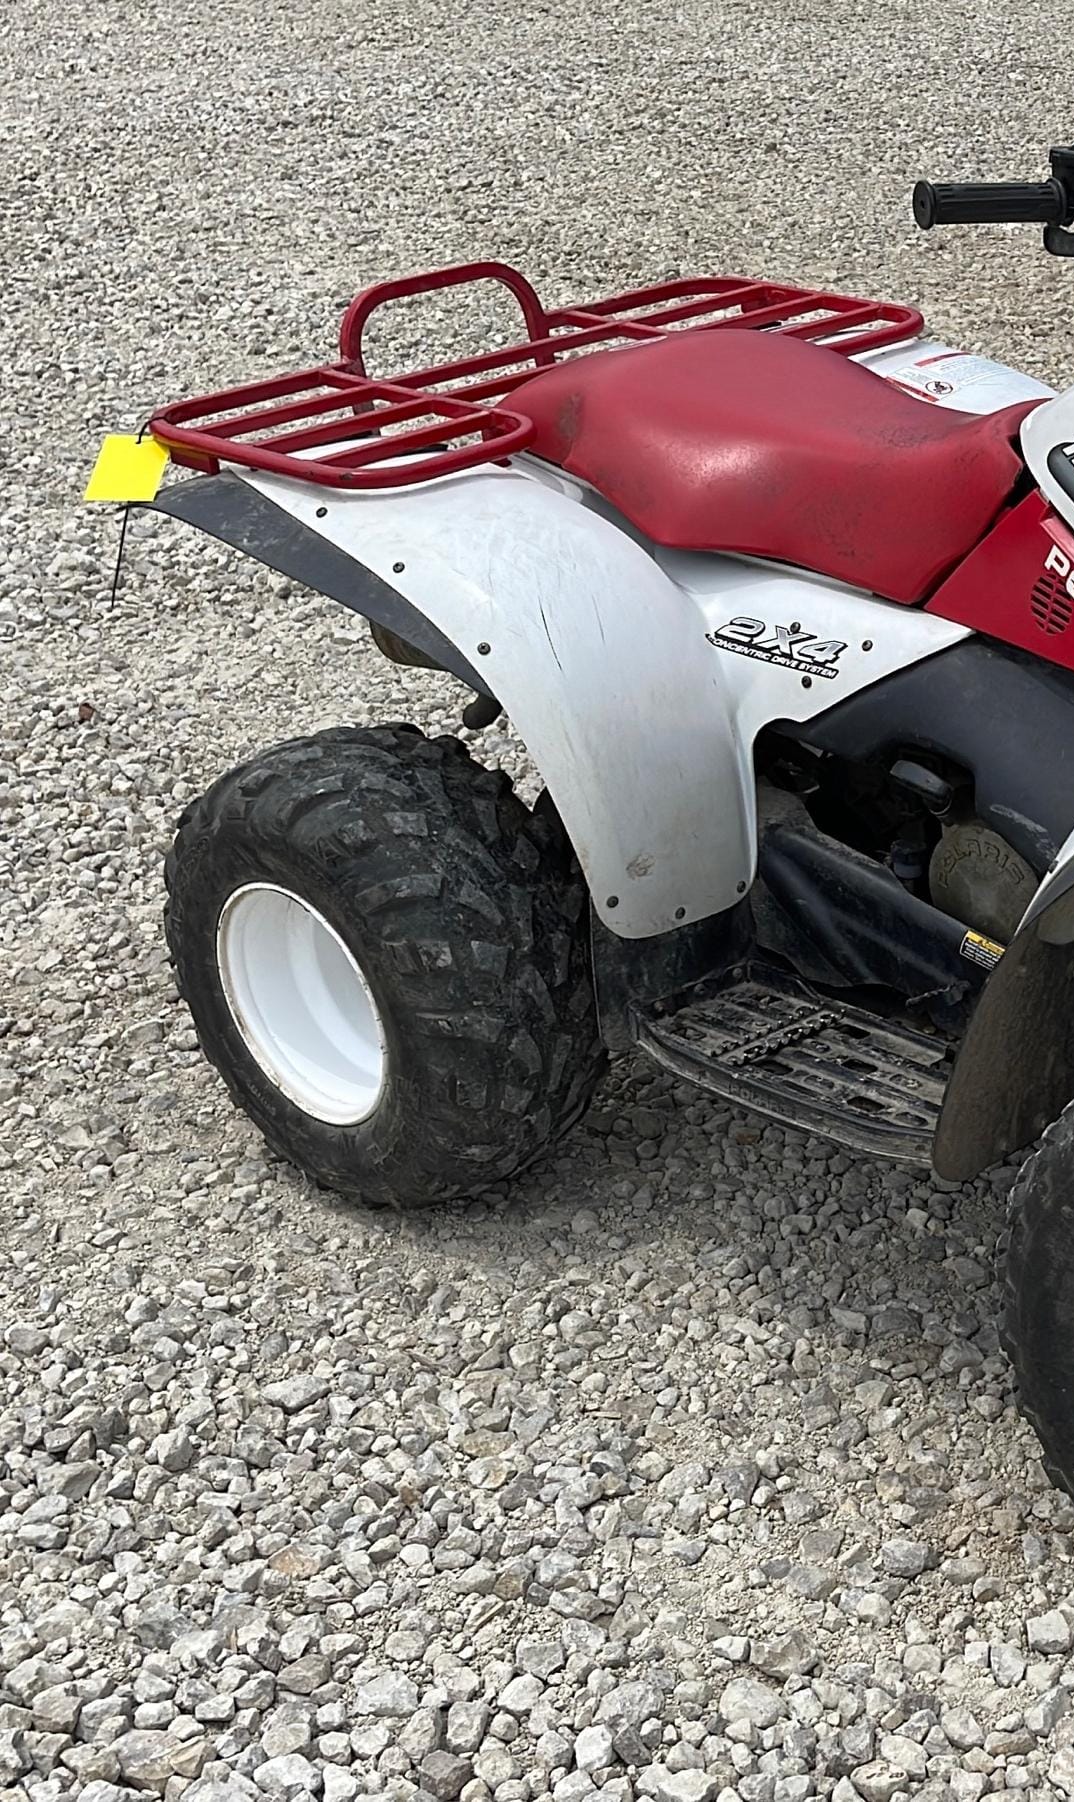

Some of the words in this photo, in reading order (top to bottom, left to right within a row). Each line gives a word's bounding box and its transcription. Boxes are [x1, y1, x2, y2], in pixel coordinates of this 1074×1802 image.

[771, 655, 799, 668] DRIVE
[799, 662, 838, 678] SYSTEM
[937, 838, 1026, 889] POLARIS
